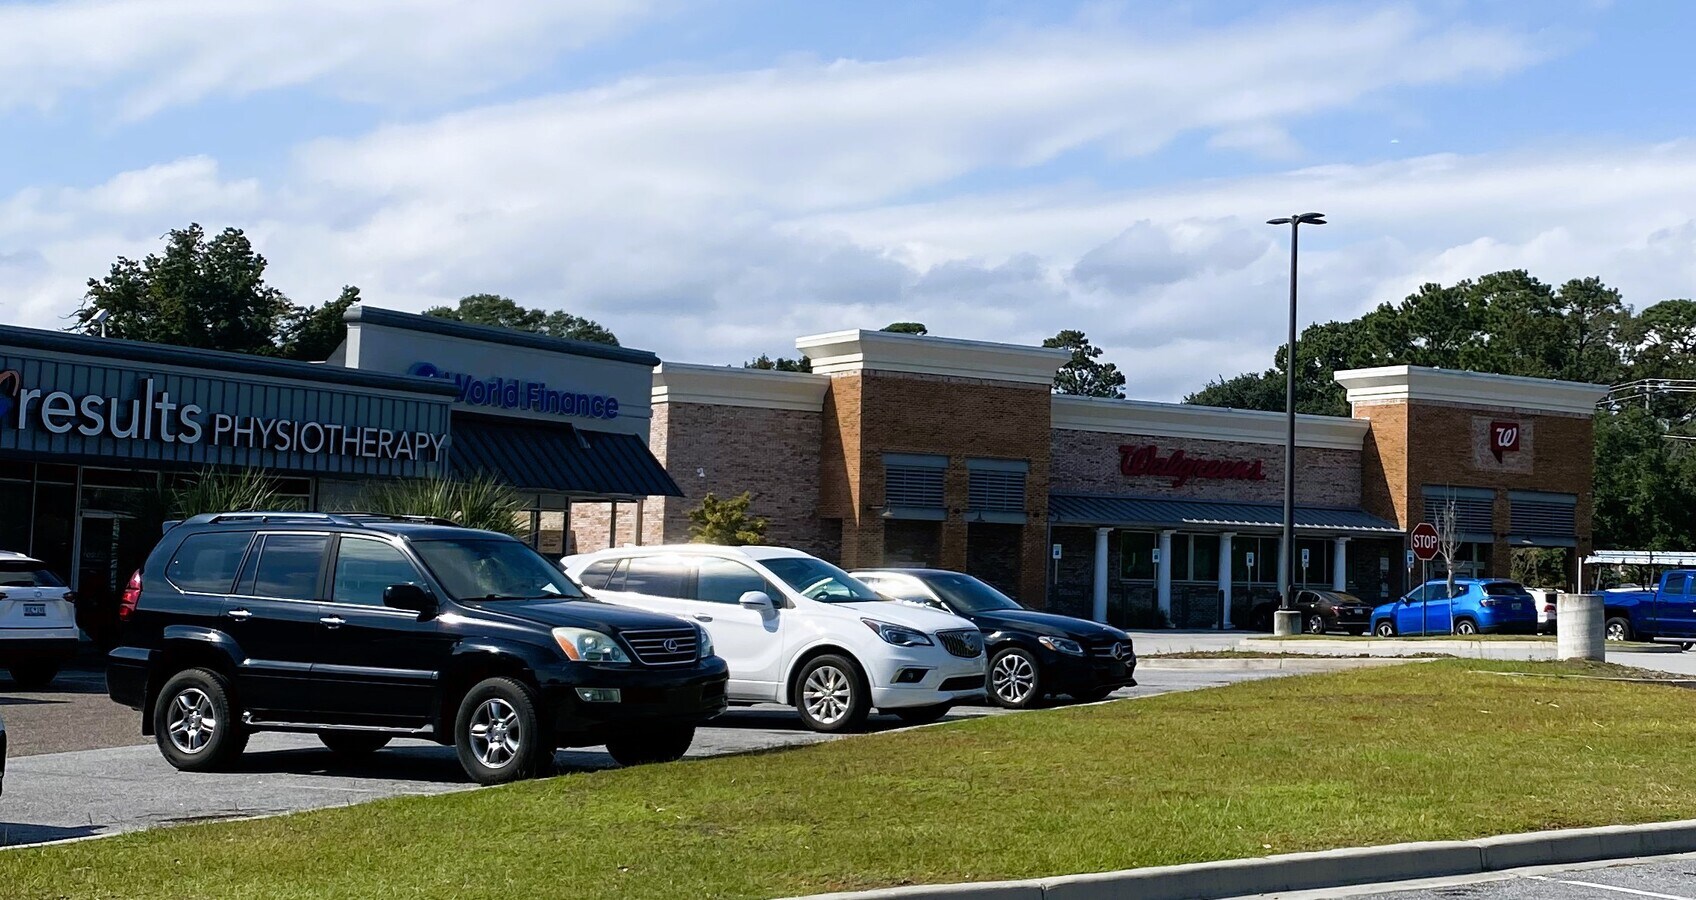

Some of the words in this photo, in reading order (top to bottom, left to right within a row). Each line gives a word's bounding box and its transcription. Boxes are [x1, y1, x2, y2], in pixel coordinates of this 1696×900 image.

[18, 378, 202, 444] results
[213, 413, 447, 462] PHYSIOTHERAPY
[527, 382, 619, 419] Finance
[1118, 445, 1266, 488] Walgreens
[1413, 534, 1437, 549] STOP
